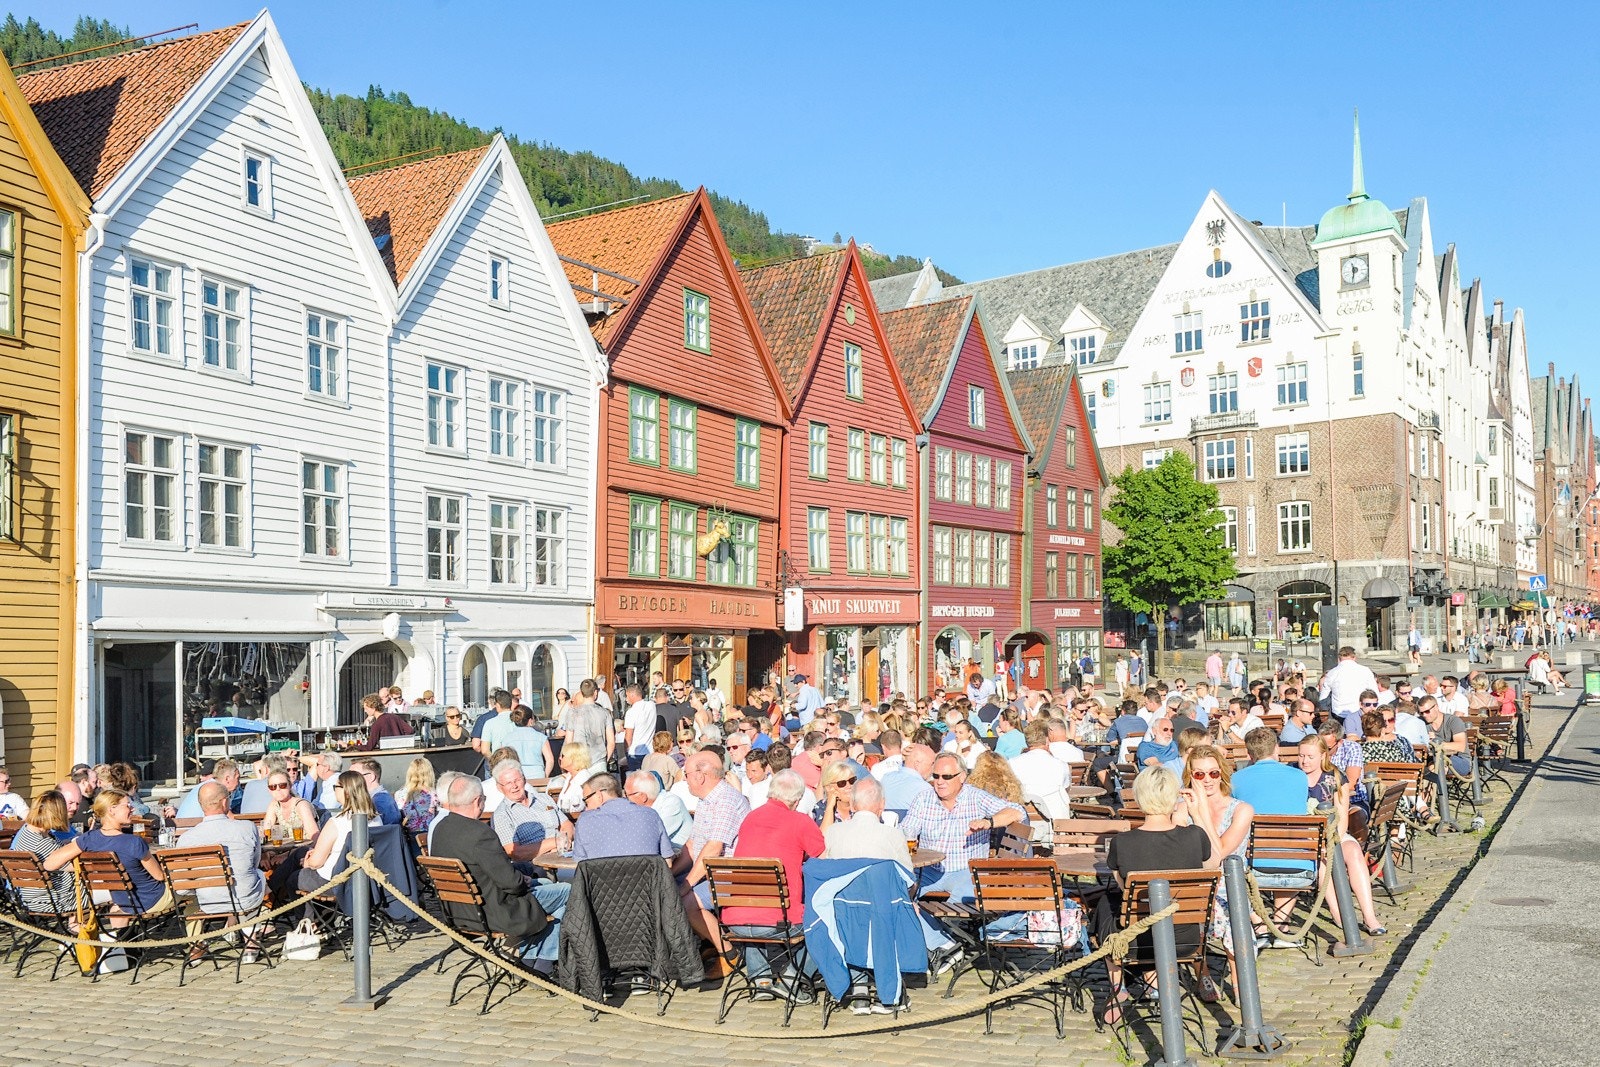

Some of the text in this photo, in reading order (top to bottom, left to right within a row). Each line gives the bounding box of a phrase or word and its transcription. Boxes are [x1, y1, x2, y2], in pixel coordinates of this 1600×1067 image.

[618, 595, 760, 617] BRYGGEN HANDEL
[812, 599, 902, 615] KNUT SKURTVEIT
[932, 605, 965, 617] BRYGGEN
